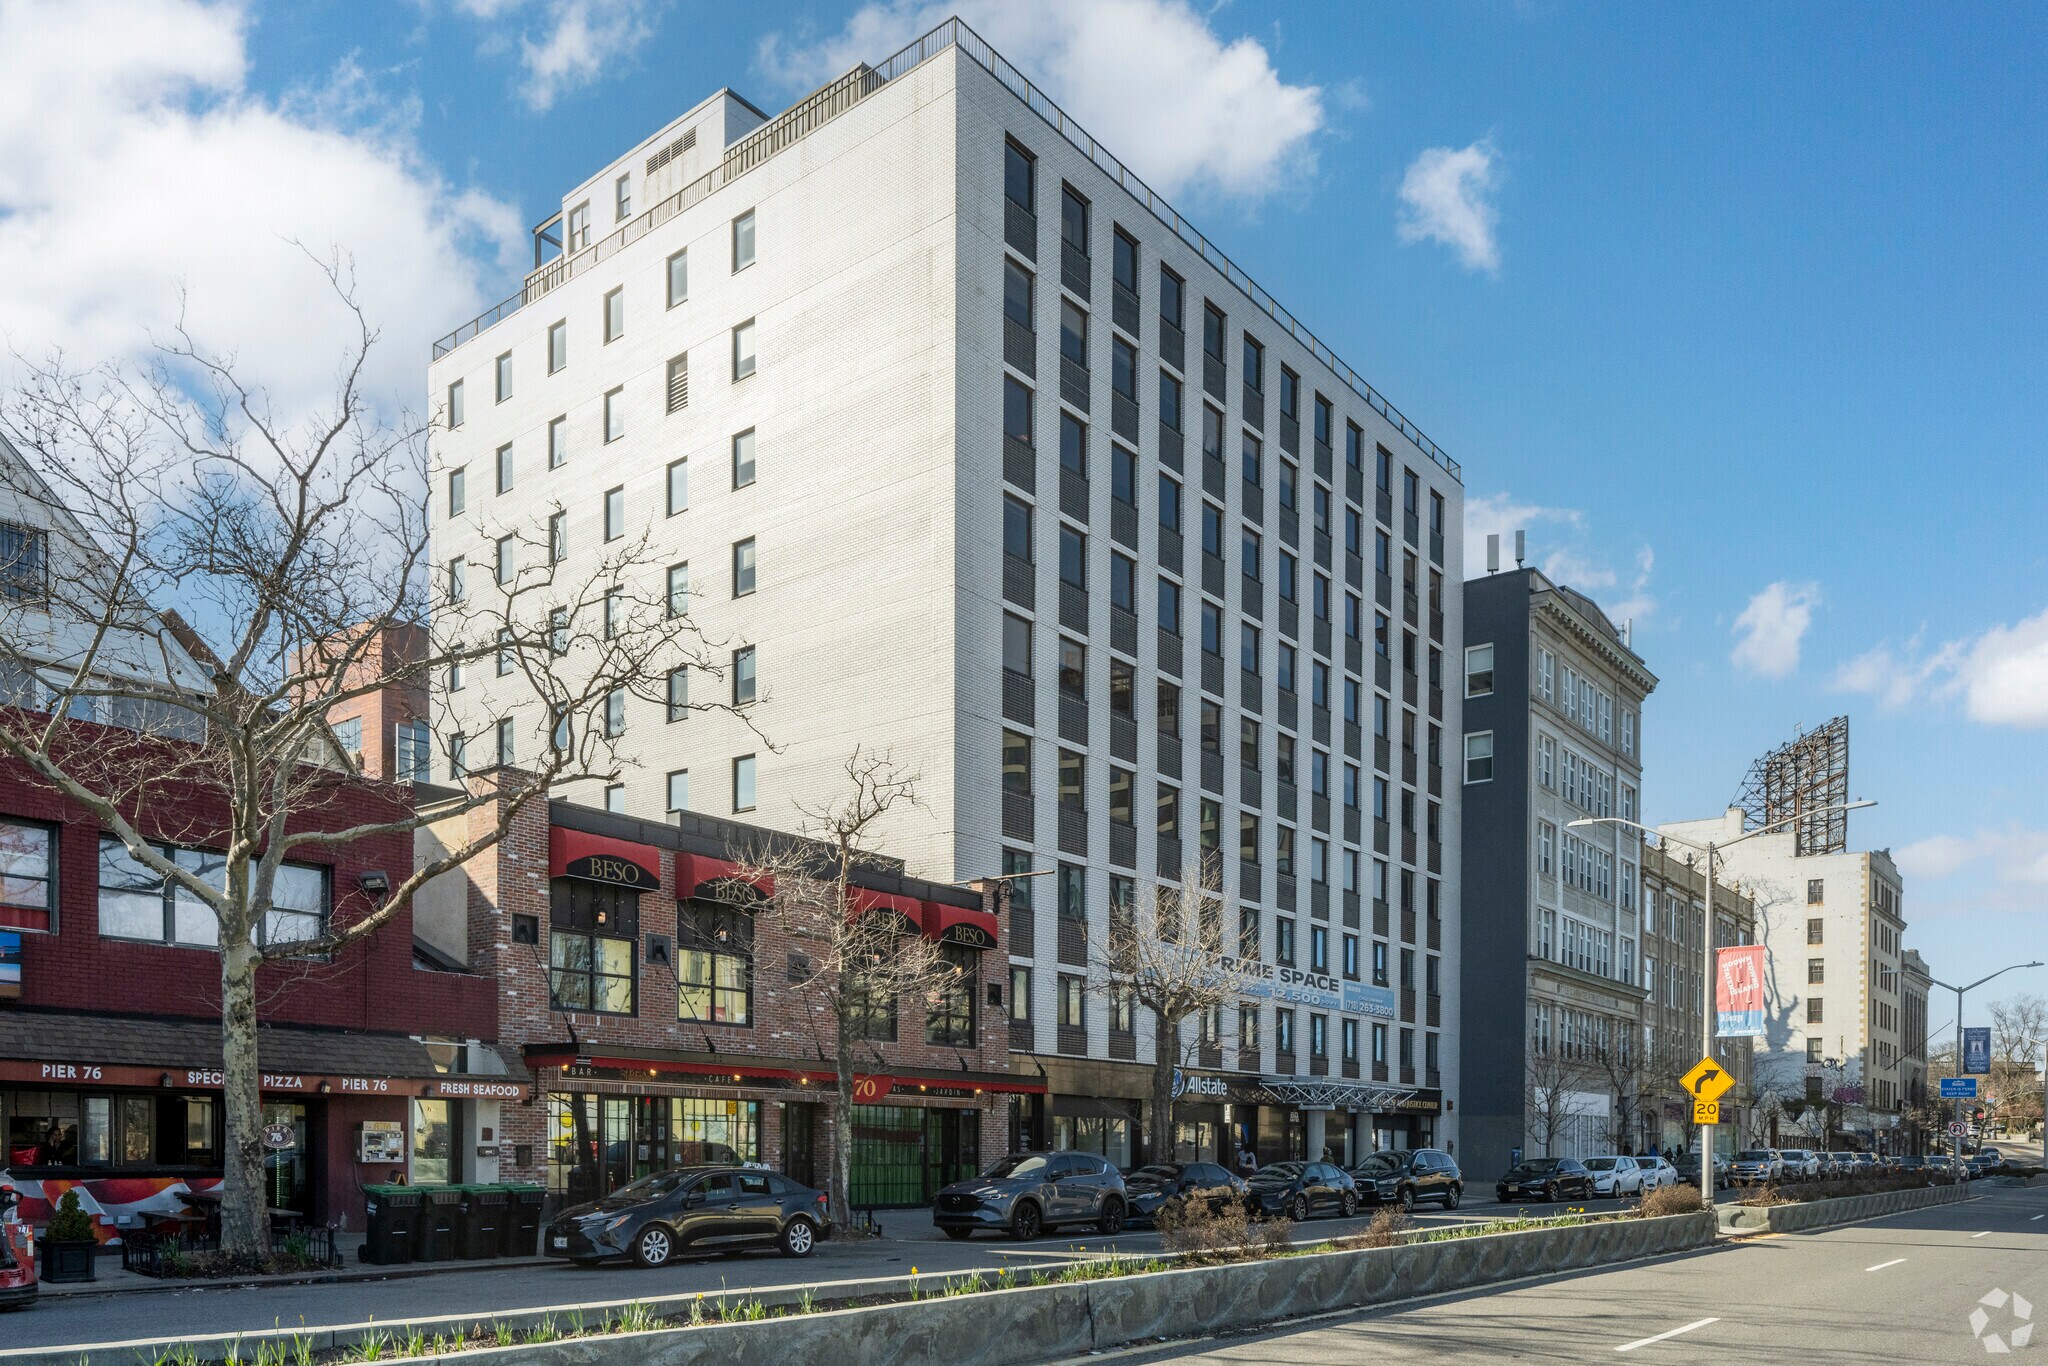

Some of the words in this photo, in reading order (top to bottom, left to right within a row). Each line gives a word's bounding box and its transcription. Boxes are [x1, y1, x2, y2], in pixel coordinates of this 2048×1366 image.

[589, 857, 639, 884] BESO
[714, 881, 756, 904] BESO
[955, 925, 985, 945] BESO
[1280, 968, 1339, 992] SPACE
[1268, 988, 1321, 1006] 12,500
[1359, 1002, 1393, 1016] 263-3800
[41, 1064, 77, 1078] PIER
[83, 1066, 102, 1080] 76
[571, 1067, 592, 1076] BAR
[187, 1071, 225, 1085] SPECI
[263, 1075, 303, 1088] PIZZA
[342, 1078, 369, 1091] PIER
[373, 1080, 388, 1092] 76
[708, 1075, 731, 1084] CAFE
[1186, 1076, 1228, 1096] Allstate
[440, 1082, 470, 1095] FRESH
[473, 1084, 520, 1097] SEAFOOD
[854, 1079, 877, 1097] 70
[935, 1088, 961, 1096] JARDIN
[1697, 1103, 1717, 1115] 20
[373, 1122, 391, 1130] ATM
[271, 1132, 283, 1142] 76
